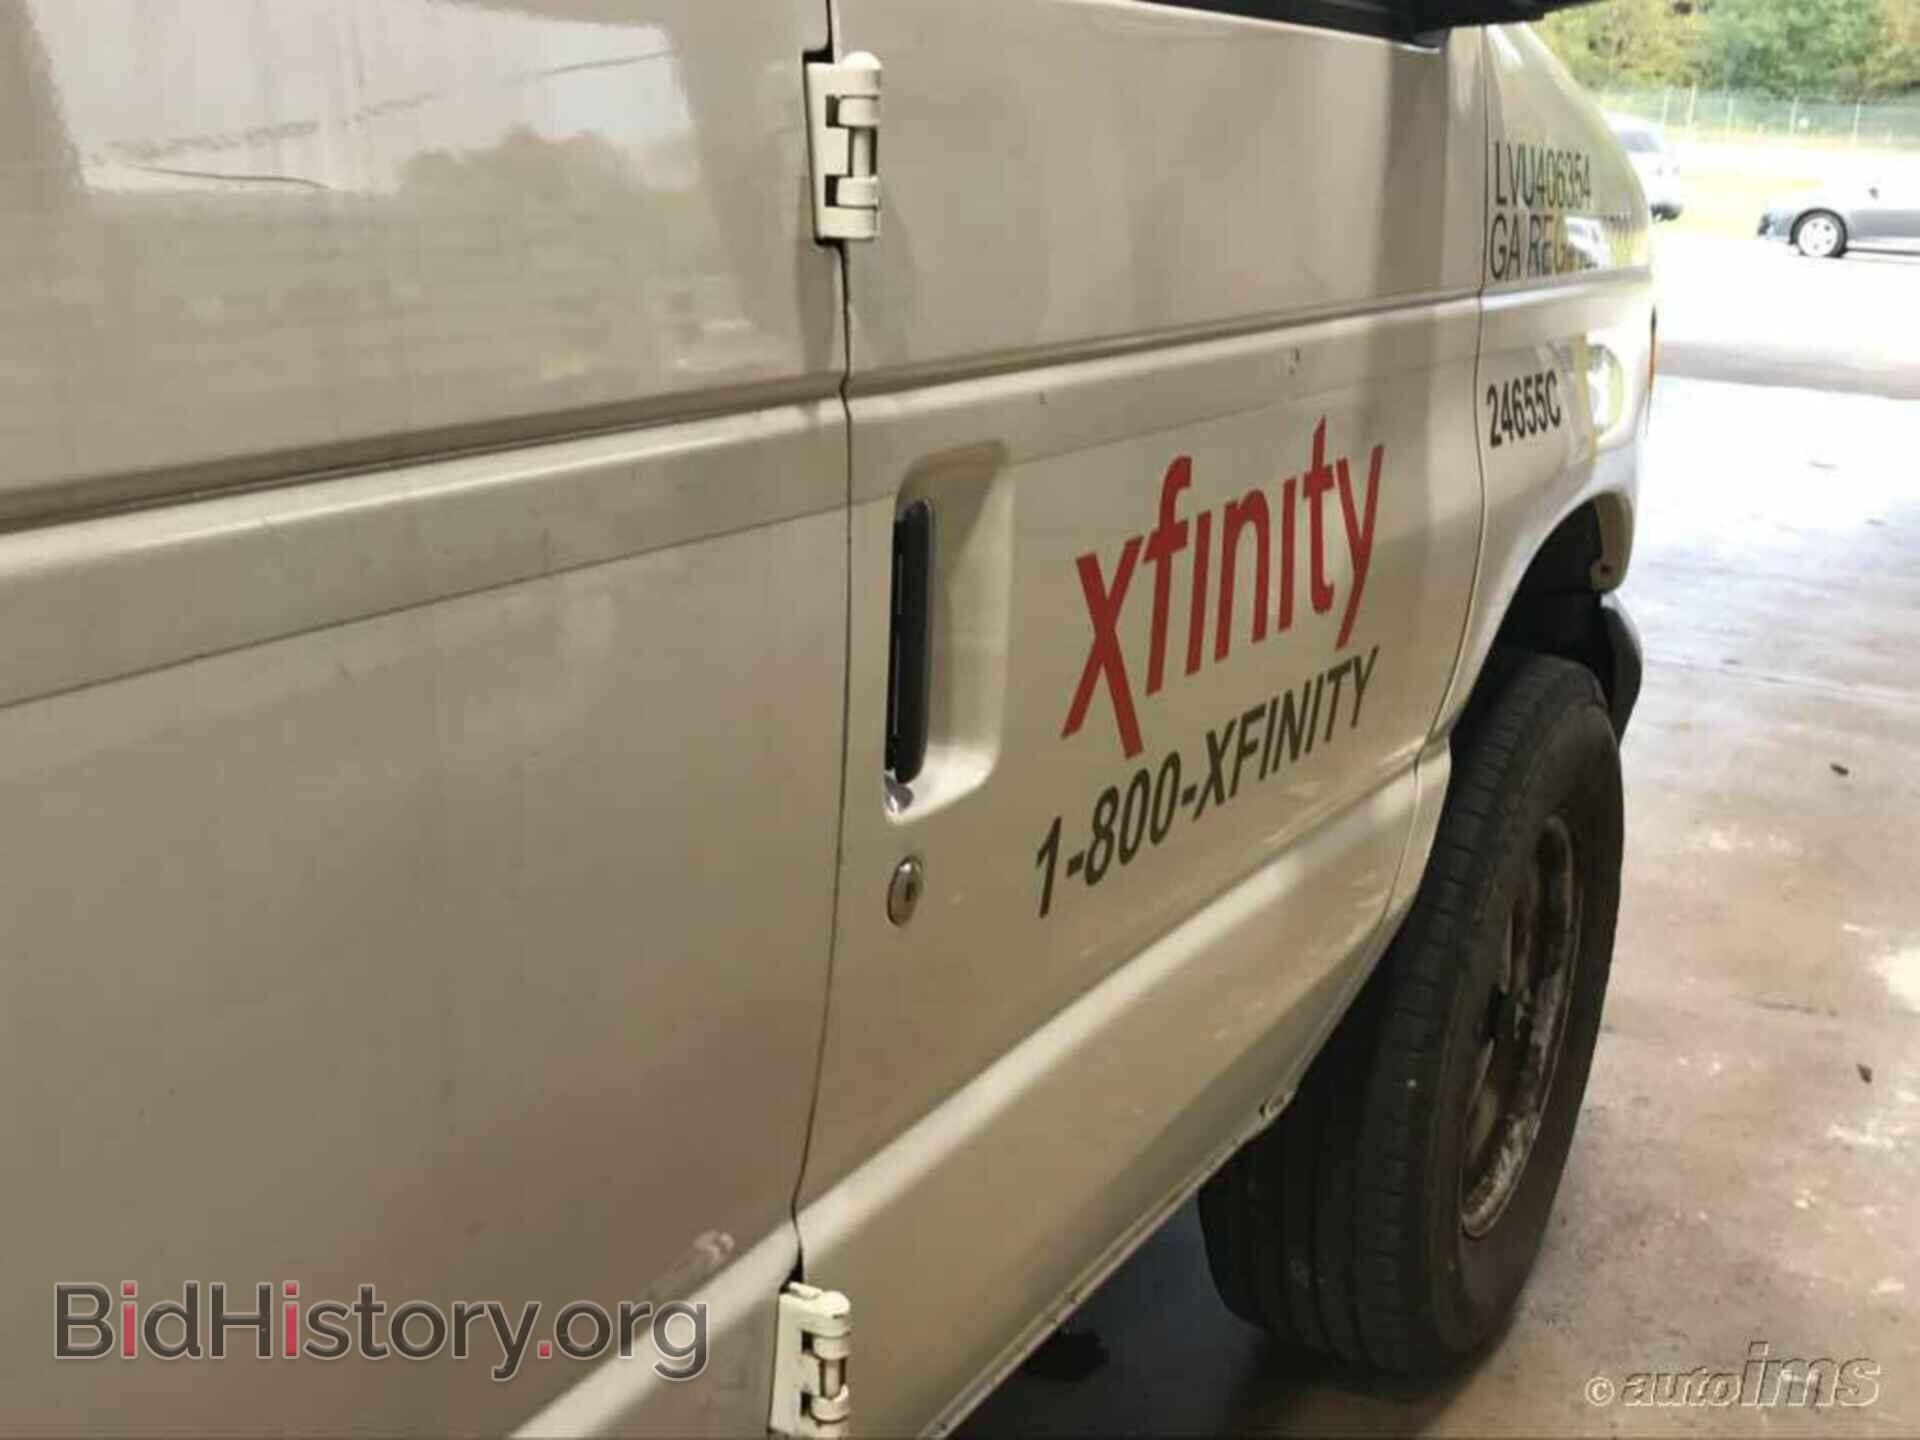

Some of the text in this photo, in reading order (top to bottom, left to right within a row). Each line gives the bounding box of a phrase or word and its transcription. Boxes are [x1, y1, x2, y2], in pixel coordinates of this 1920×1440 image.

[1494, 140, 1592, 209] LVU406354
[1490, 212, 1522, 282] GA
[1486, 369, 1562, 448] 24655C
[1060, 414, 1385, 760] xfinity
[1035, 644, 1380, 919] 1-800-XFINITY
